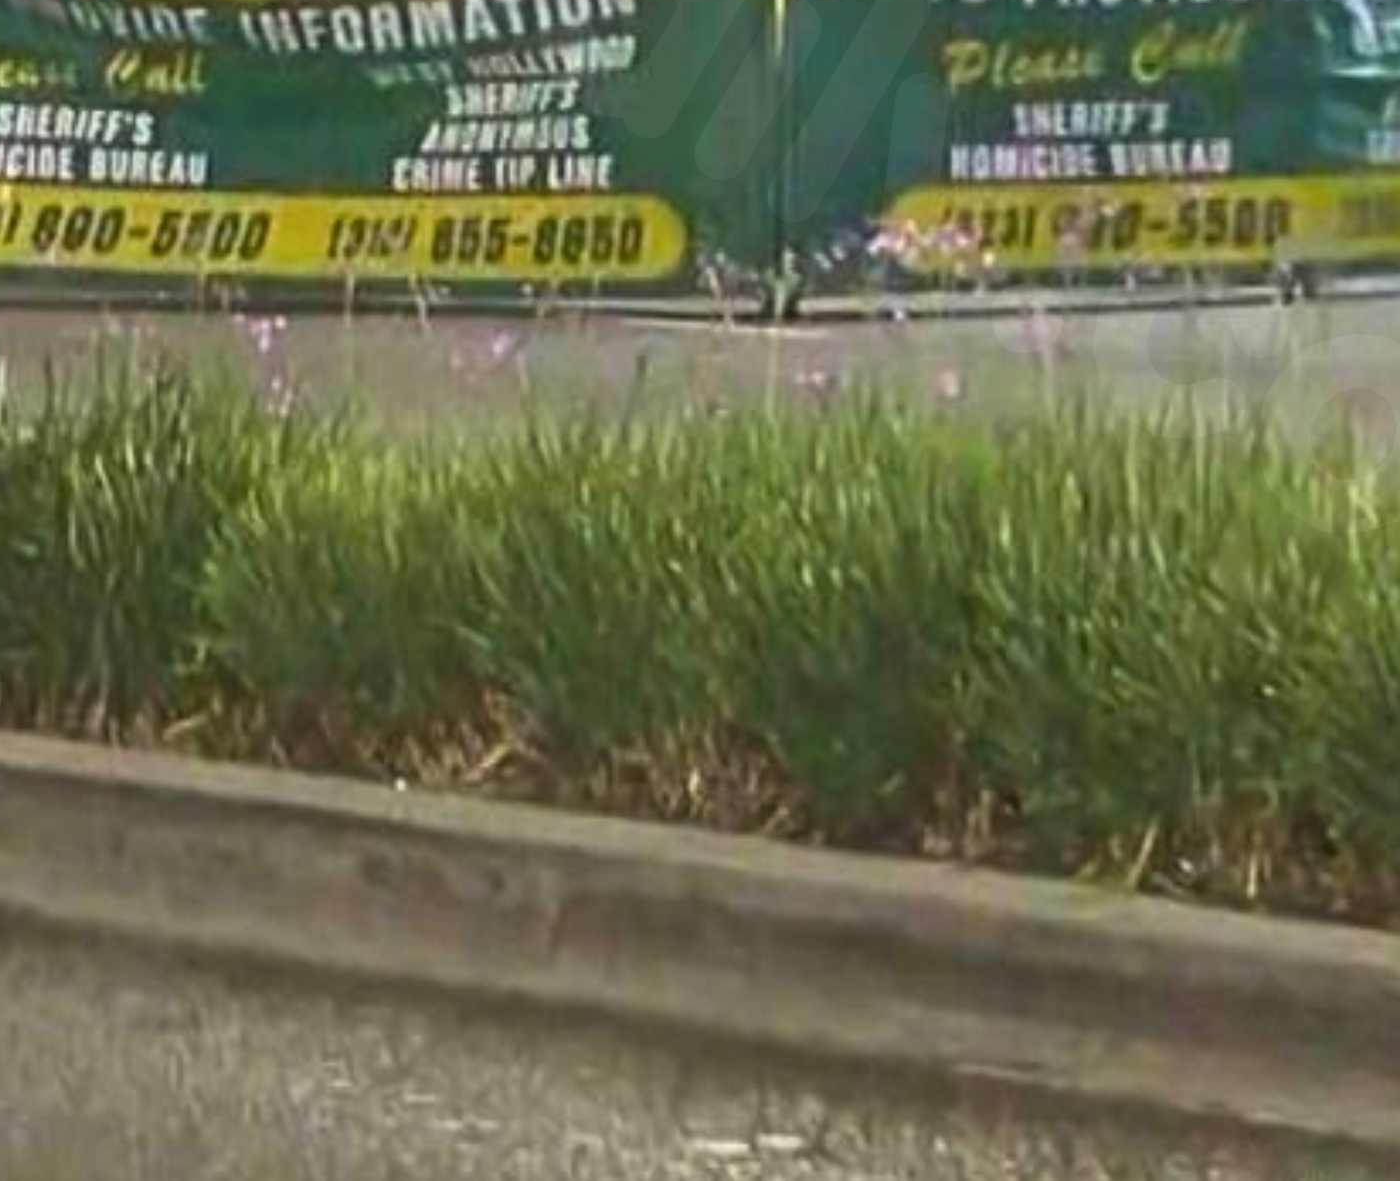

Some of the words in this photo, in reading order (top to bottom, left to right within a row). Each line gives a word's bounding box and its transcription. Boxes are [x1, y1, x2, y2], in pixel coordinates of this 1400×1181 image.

[104, 47, 209, 97] Call
[941, 38, 1105, 96] Please
[88, 147, 210, 186] BUREAU
[392, 155, 483, 191] CRIME
[494, 155, 538, 191] TIP
[546, 154, 614, 191] LINE
[950, 142, 1099, 181] HOMICIDE
[1108, 137, 1233, 176] BUREAU
